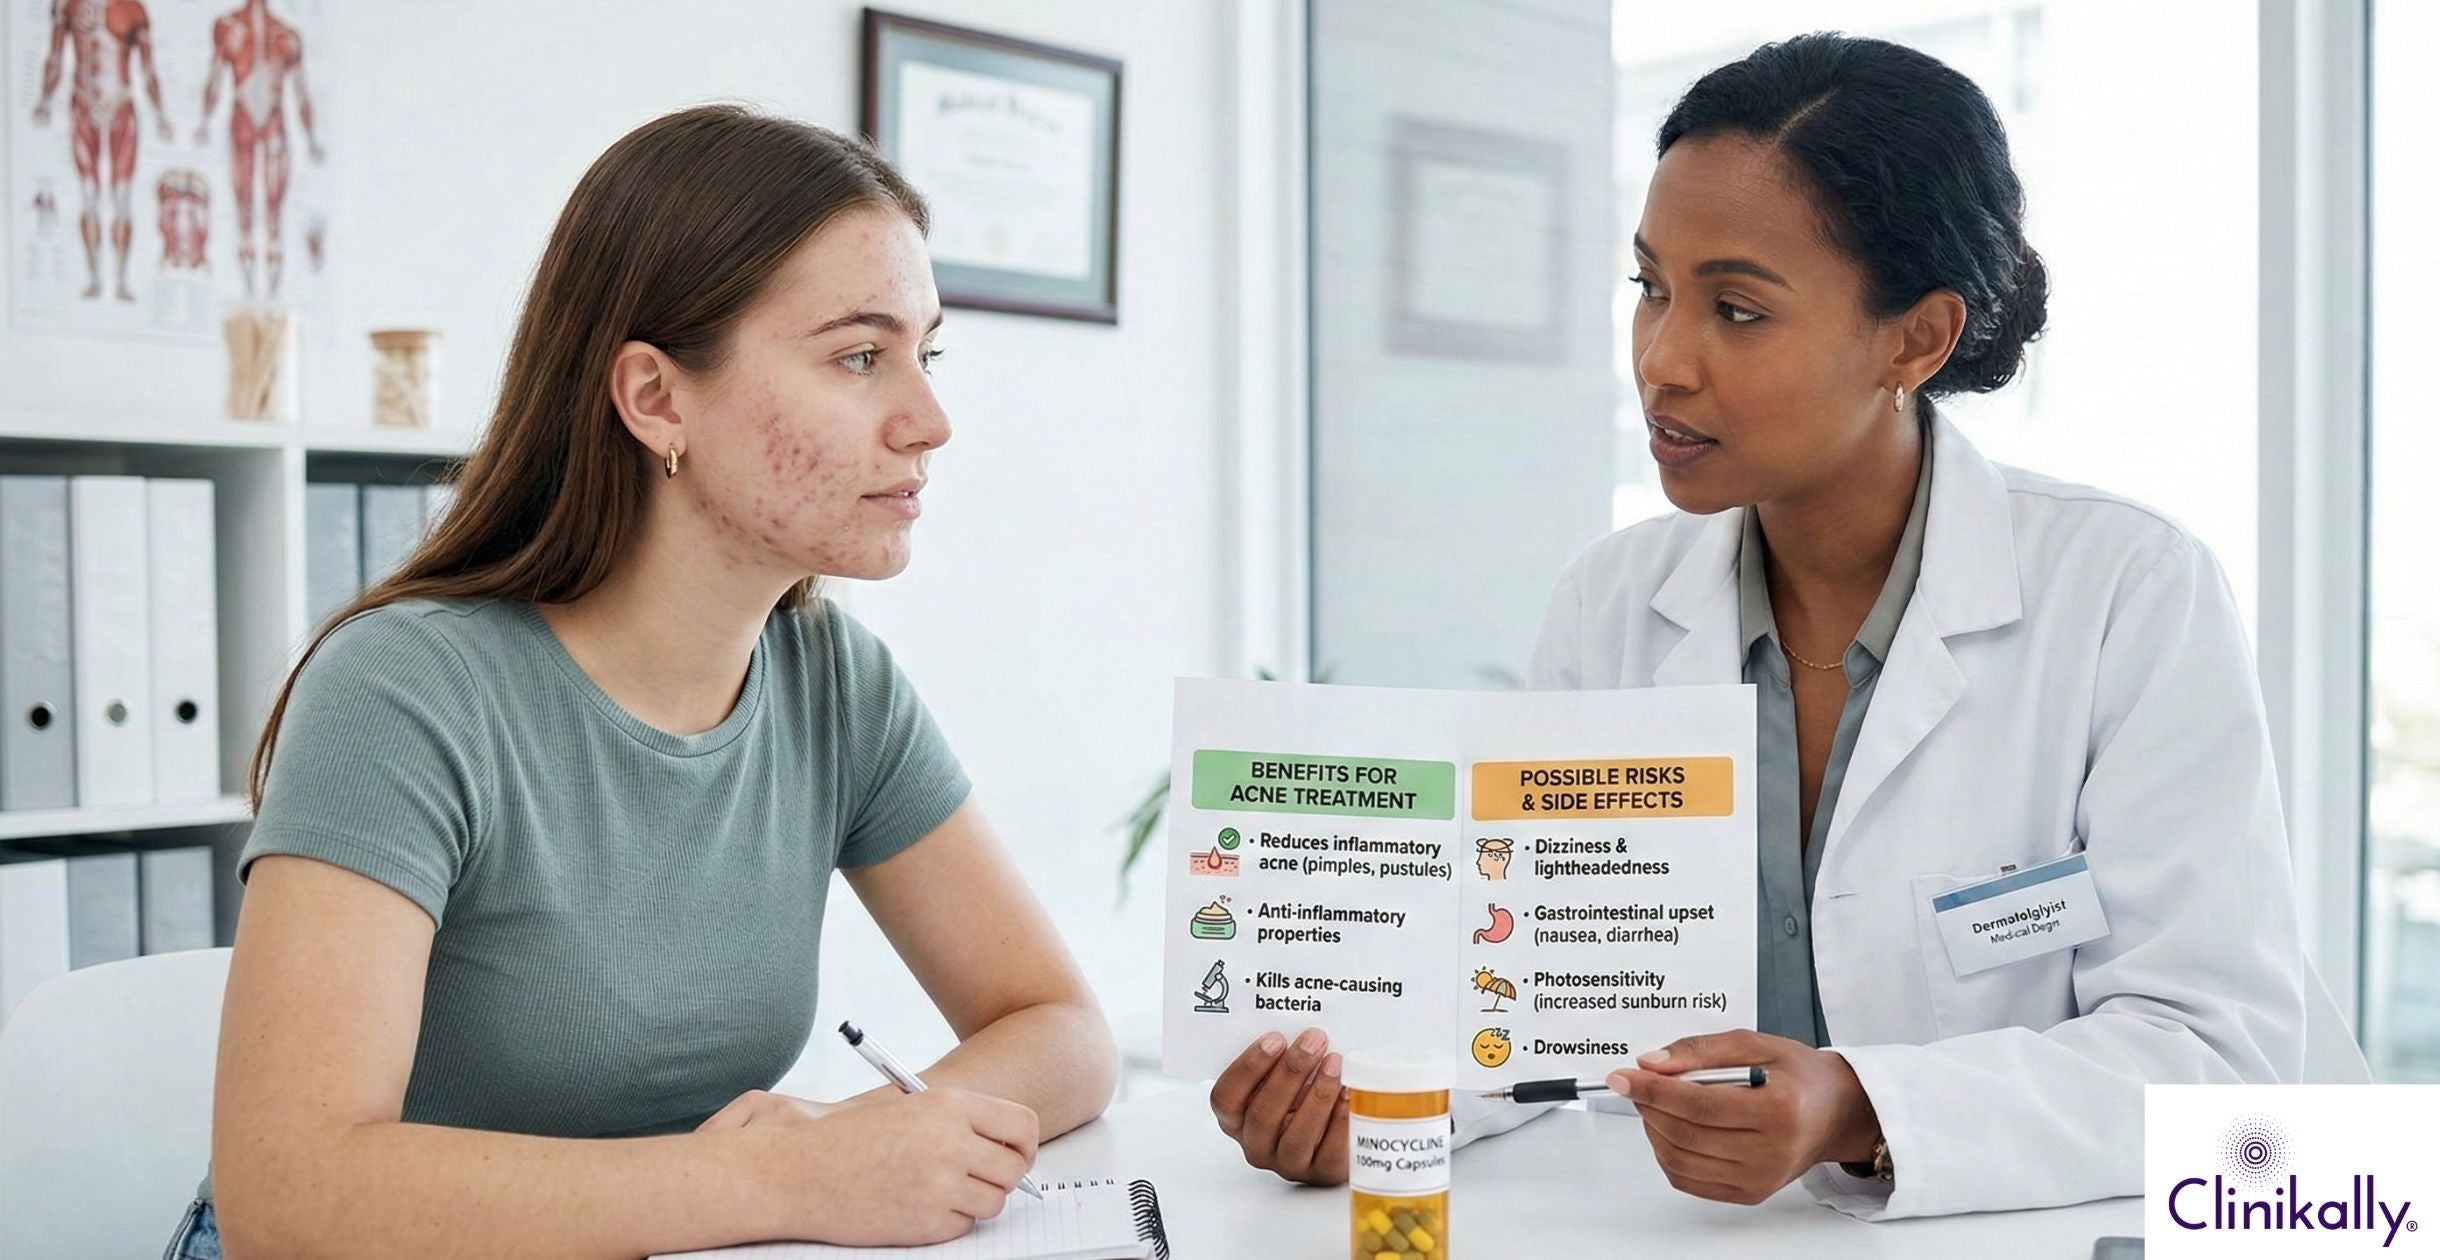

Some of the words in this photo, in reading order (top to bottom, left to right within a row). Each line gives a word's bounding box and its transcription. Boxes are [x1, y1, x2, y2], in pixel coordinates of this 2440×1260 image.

[1251, 762, 1349, 783] BENEFITS
[1355, 767, 1397, 785] FOR
[1520, 768, 1619, 786] POSSIBLE
[1625, 766, 1685, 784] RISKS
[1230, 785, 1287, 804] ACNE
[1294, 788, 1417, 809] TREATMENT
[1522, 794, 1535, 811] &
[1541, 793, 1589, 810] SIDE
[1594, 791, 1684, 810] EFFECTS
[1260, 833, 1329, 851] Reduces
[1333, 835, 1441, 859] inflammatory
[1535, 838, 1611, 854] Dizziness
[1615, 838, 1628, 854] &
[1259, 857, 1299, 871] acne
[1303, 856, 1375, 876] (pimples,
[1380, 859, 1452, 881] pustules)
[1534, 859, 1670, 879] lightheadedness
[1257, 903, 1406, 928] Anti-inflammatory
[1534, 904, 1664, 921] Gastrointestinal
[1668, 905, 1714, 924] upset
[1257, 926, 1341, 945] properties
[1534, 928, 1601, 946] (nausea,
[1606, 927, 1679, 946] diarrhea)
[1256, 972, 1290, 988] Kills
[1295, 976, 1402, 997] acne-causing
[1534, 972, 1665, 991] Photosensitivity
[1255, 994, 1321, 1012] bacteria
[1534, 994, 1617, 1012] (increased
[1621, 994, 1687, 1009] sunburn
[1692, 993, 1727, 1012] risk)
[1534, 1039, 1629, 1055] Drowsiness
[1357, 1135, 1444, 1152] MINOCYCLINE
